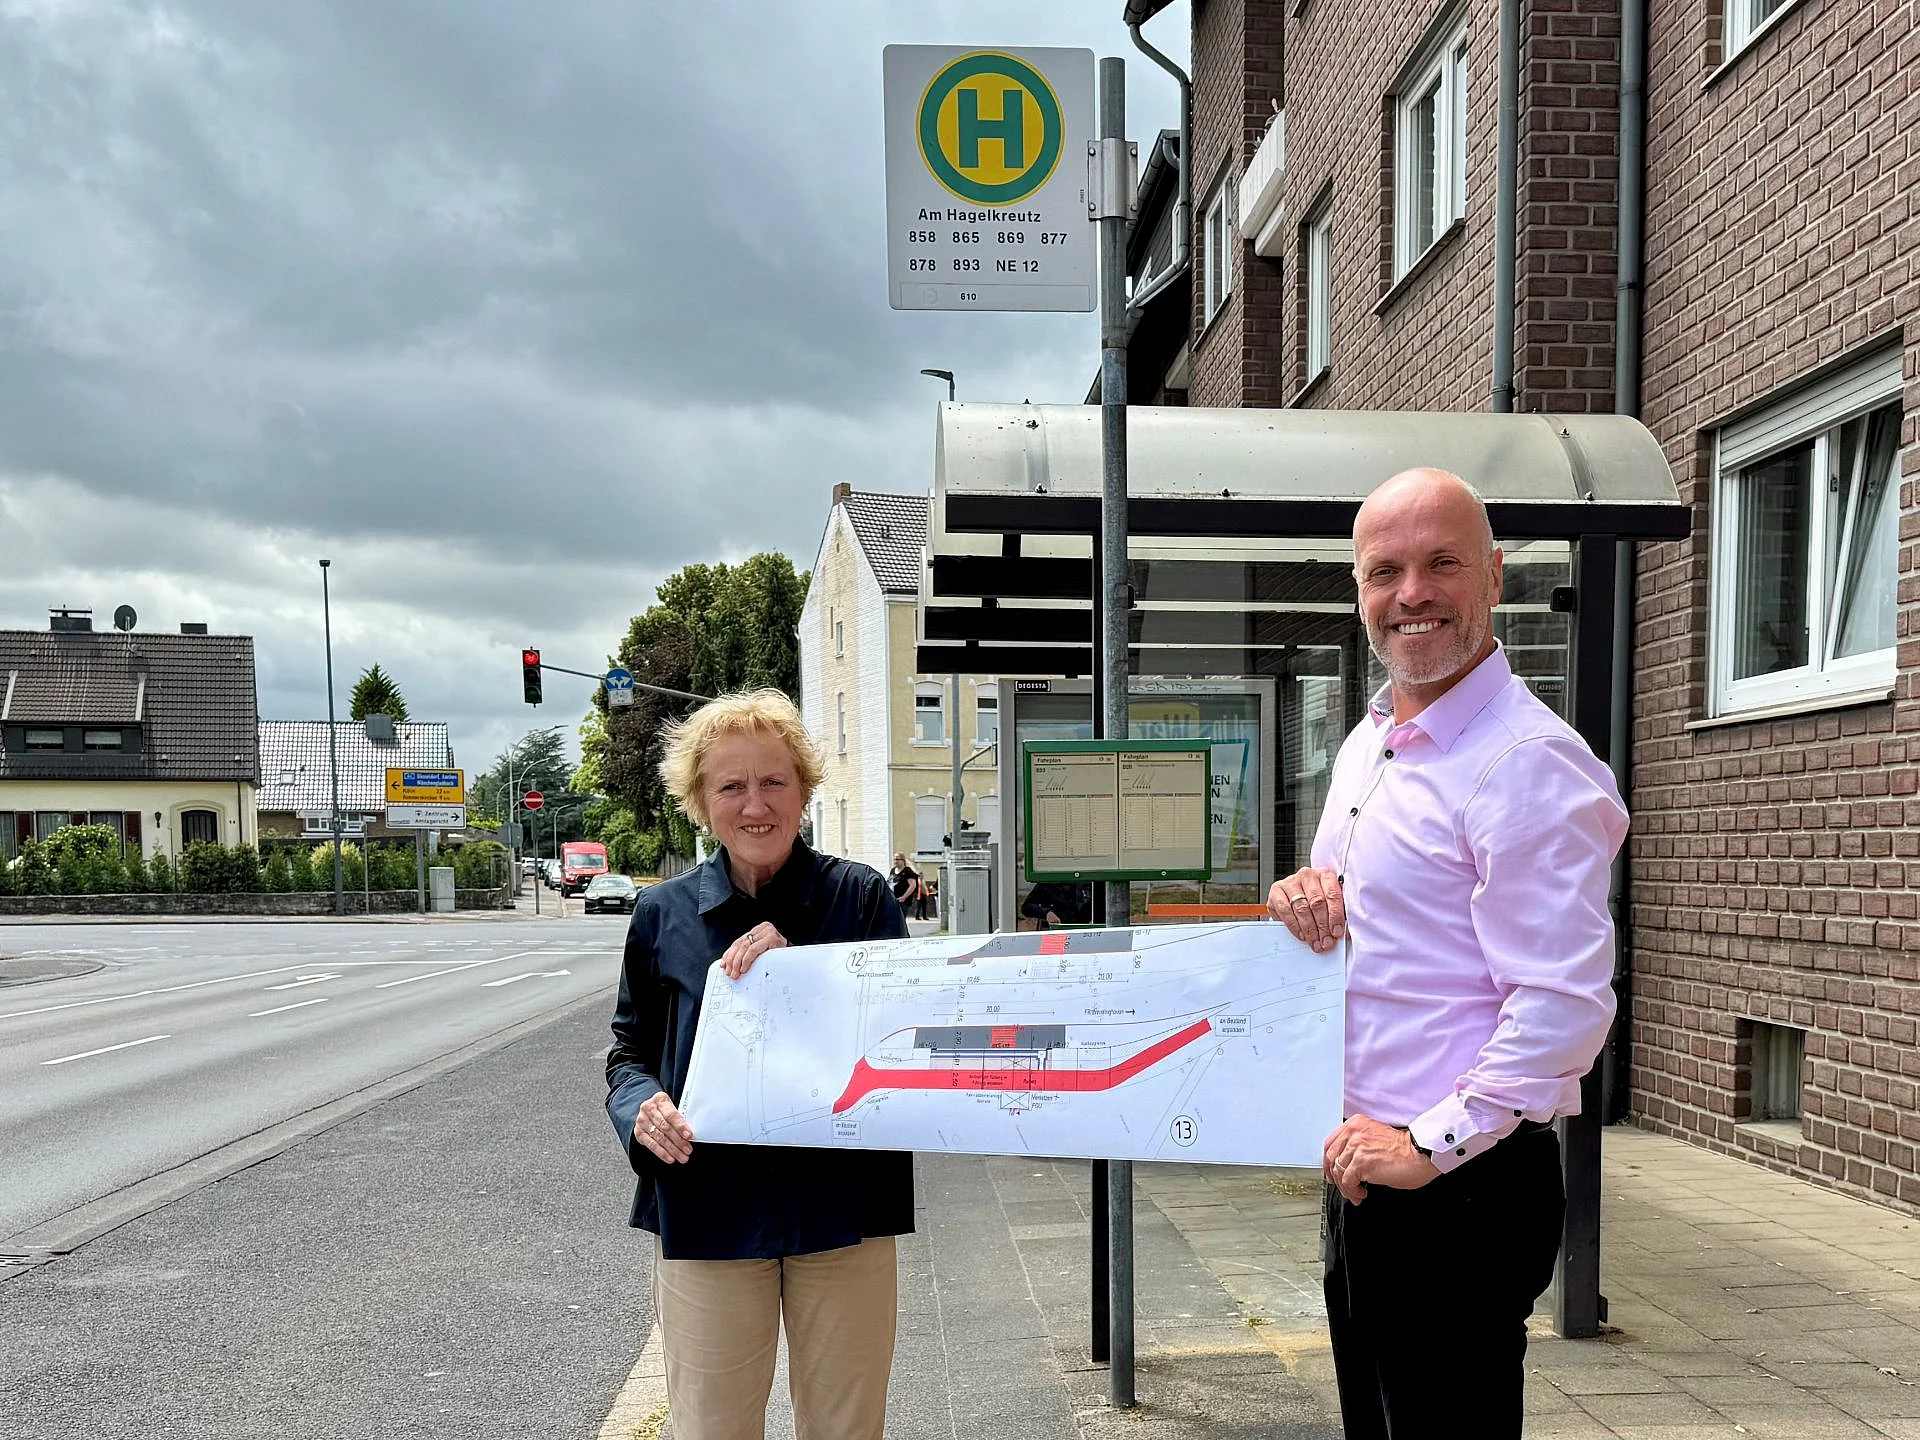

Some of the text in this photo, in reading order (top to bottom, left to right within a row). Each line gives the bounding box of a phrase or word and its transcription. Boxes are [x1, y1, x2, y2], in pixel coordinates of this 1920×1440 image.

[957, 88, 1024, 169] H
[918, 208, 1041, 224] Am Hagelkreutz
[908, 231, 1068, 245] 858 865 869 877
[909, 259, 1039, 272] 878 893 NE 12
[960, 293, 977, 301] 610
[1016, 682, 1049, 691] DEGESTA
[851, 951, 864, 967] 12
[1175, 1120, 1192, 1139] 13
